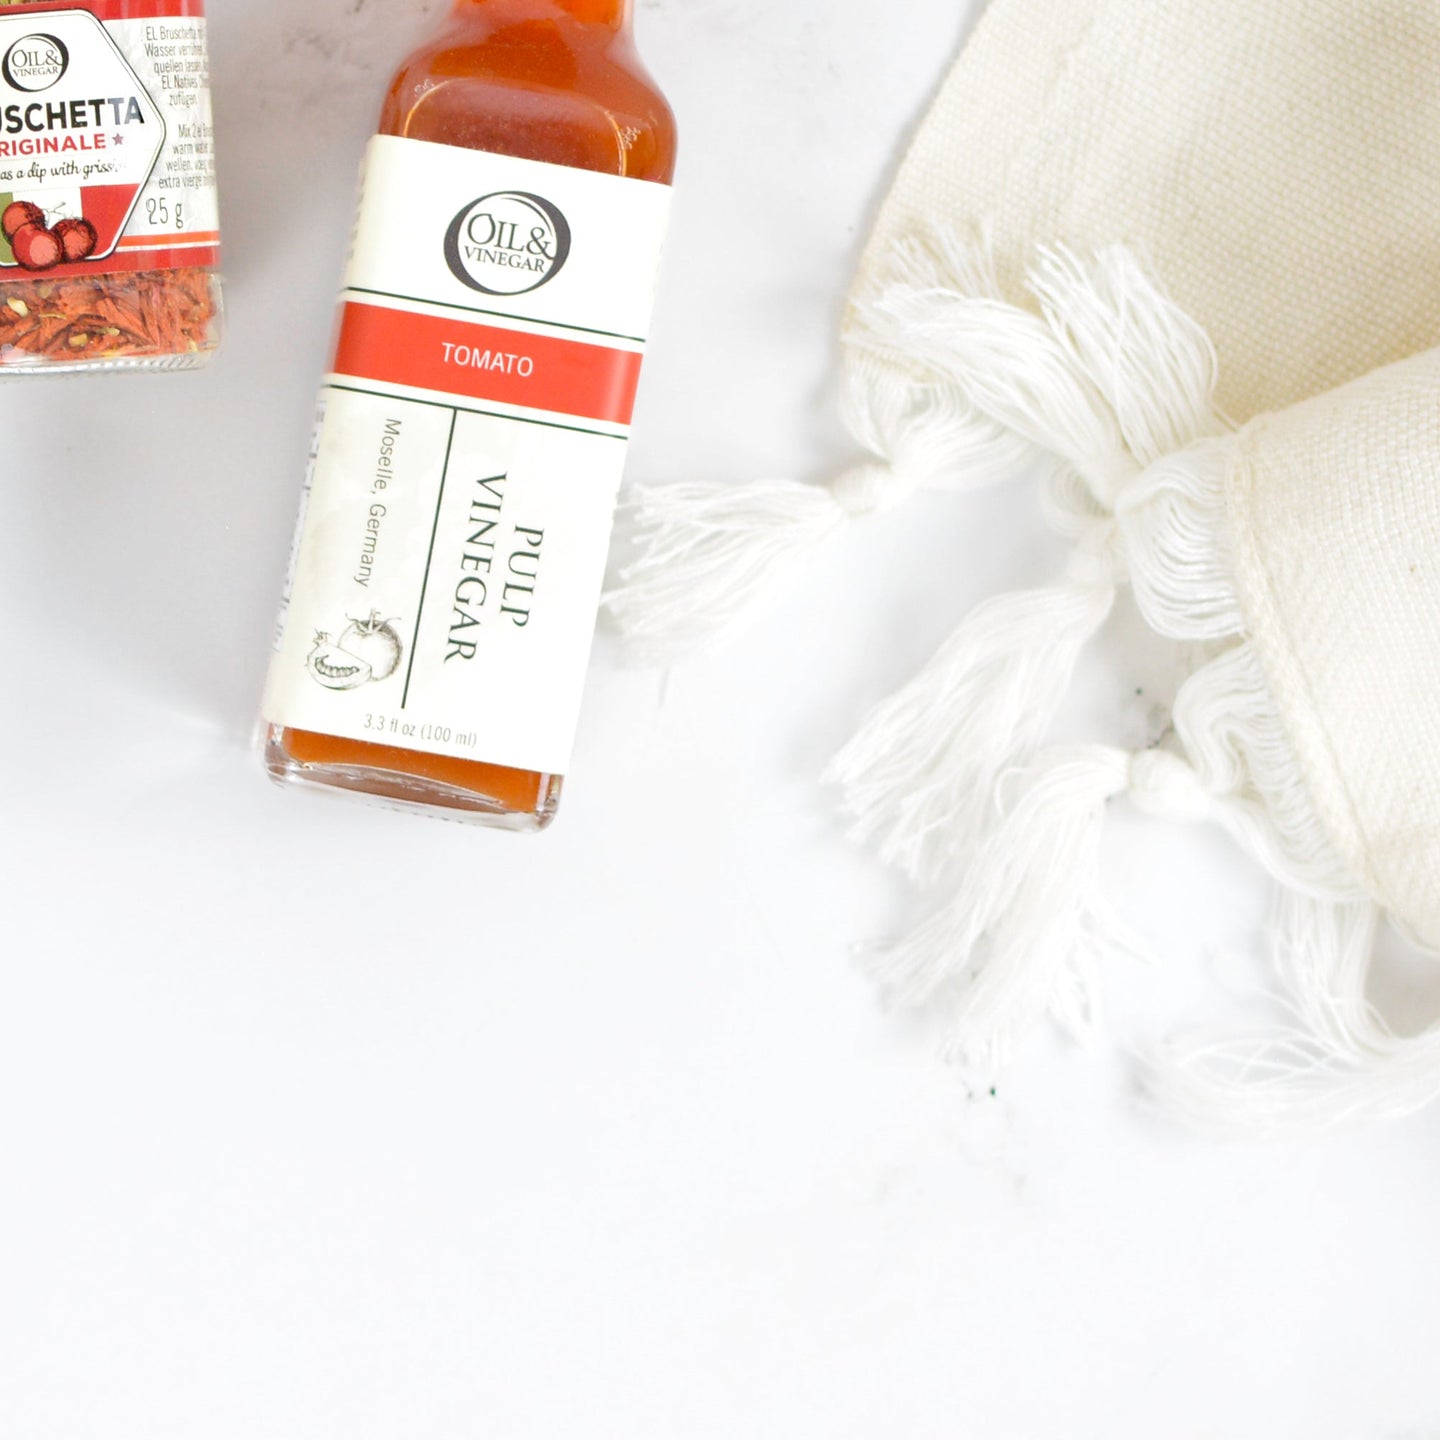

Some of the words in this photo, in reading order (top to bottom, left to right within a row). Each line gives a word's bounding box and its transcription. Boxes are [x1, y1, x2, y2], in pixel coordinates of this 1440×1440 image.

[13, 66, 59, 77] VINEGAR
[0, 171, 13, 181] as
[16, 169, 24, 179] a
[27, 162, 47, 183] dip
[51, 160, 80, 177] with
[159, 176, 180, 189] extra
[145, 197, 169, 225] 25
[174, 202, 184, 229] g
[463, 245, 545, 273] VINEGAR
[441, 342, 533, 377] TOMATO
[370, 417, 402, 495] Moselle,
[354, 503, 387, 588] Germany
[444, 471, 508, 664] VINEGAR
[500, 524, 545, 628] PULP
[364, 713, 385, 732] 3.3
[390, 717, 399, 733] fl
[401, 721, 415, 737] oz
[420, 722, 452, 743] (100
[455, 730, 478, 749] ml)
